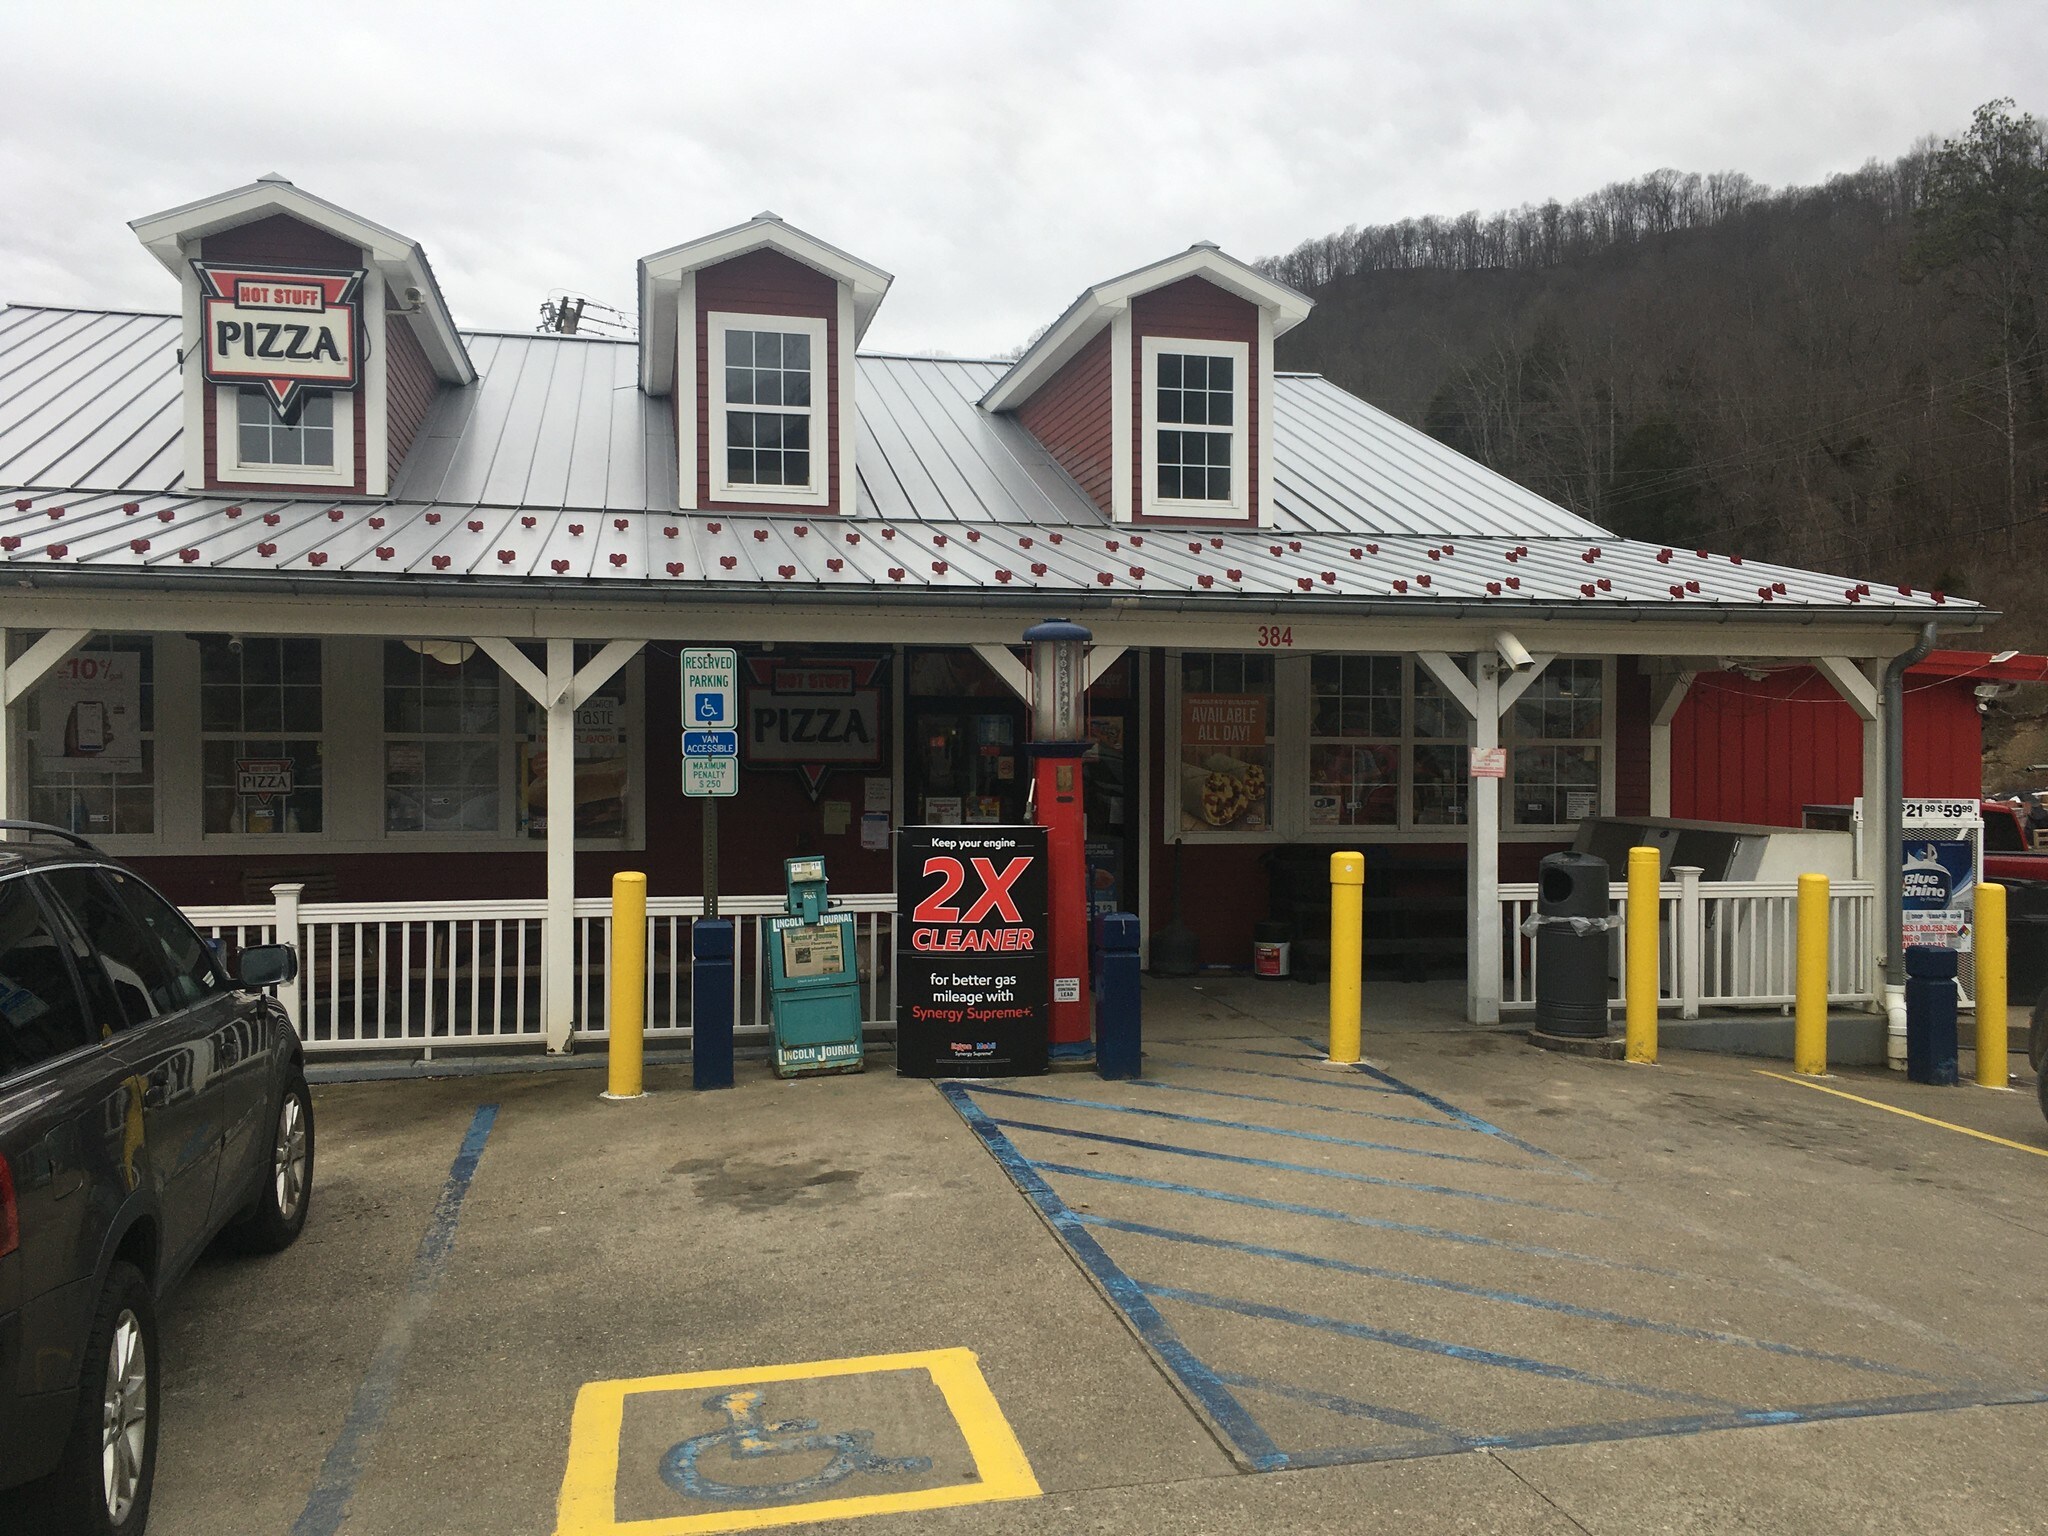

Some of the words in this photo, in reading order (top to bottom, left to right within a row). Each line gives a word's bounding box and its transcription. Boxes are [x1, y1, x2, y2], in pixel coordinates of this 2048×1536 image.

[240, 286, 268, 304] HOT
[274, 288, 318, 306] STUFF
[216, 320, 342, 362] PIZZA
[1258, 626, 1293, 647] 384
[685, 656, 732, 669] RESERVED
[689, 675, 729, 688] PARKING
[777, 673, 803, 689] HOT
[808, 673, 850, 689] STUFF
[1191, 706, 1257, 723] AVAILABLE
[754, 708, 870, 743] PIZZA
[1198, 724, 1221, 741] ALL
[1223, 725, 1251, 741] DAY!
[701, 735, 719, 743] VAN
[686, 744, 734, 753] ACCESSIBLE
[692, 762, 727, 770] MAXIMUM
[242, 776, 287, 788] PIZZA
[693, 771, 726, 779] PENALTY
[931, 838, 957, 850] Keep
[958, 840, 982, 850] your
[983, 838, 1016, 850] engine
[1904, 873, 1939, 885] Blue
[912, 856, 1035, 923] 2X
[772, 916, 804, 933] LINCOLN
[817, 913, 853, 926] JOURNAL
[912, 928, 1035, 952] CLEANER
[930, 973, 949, 986] for
[952, 973, 992, 986] better
[995, 975, 1017, 989] gas
[986, 989, 1014, 1002] with
[912, 1005, 964, 1023] Synergy
[976, 1042, 997, 1050] Mobil
[778, 1047, 815, 1066] LINCOLN
[817, 1044, 860, 1062] JOURNAL
